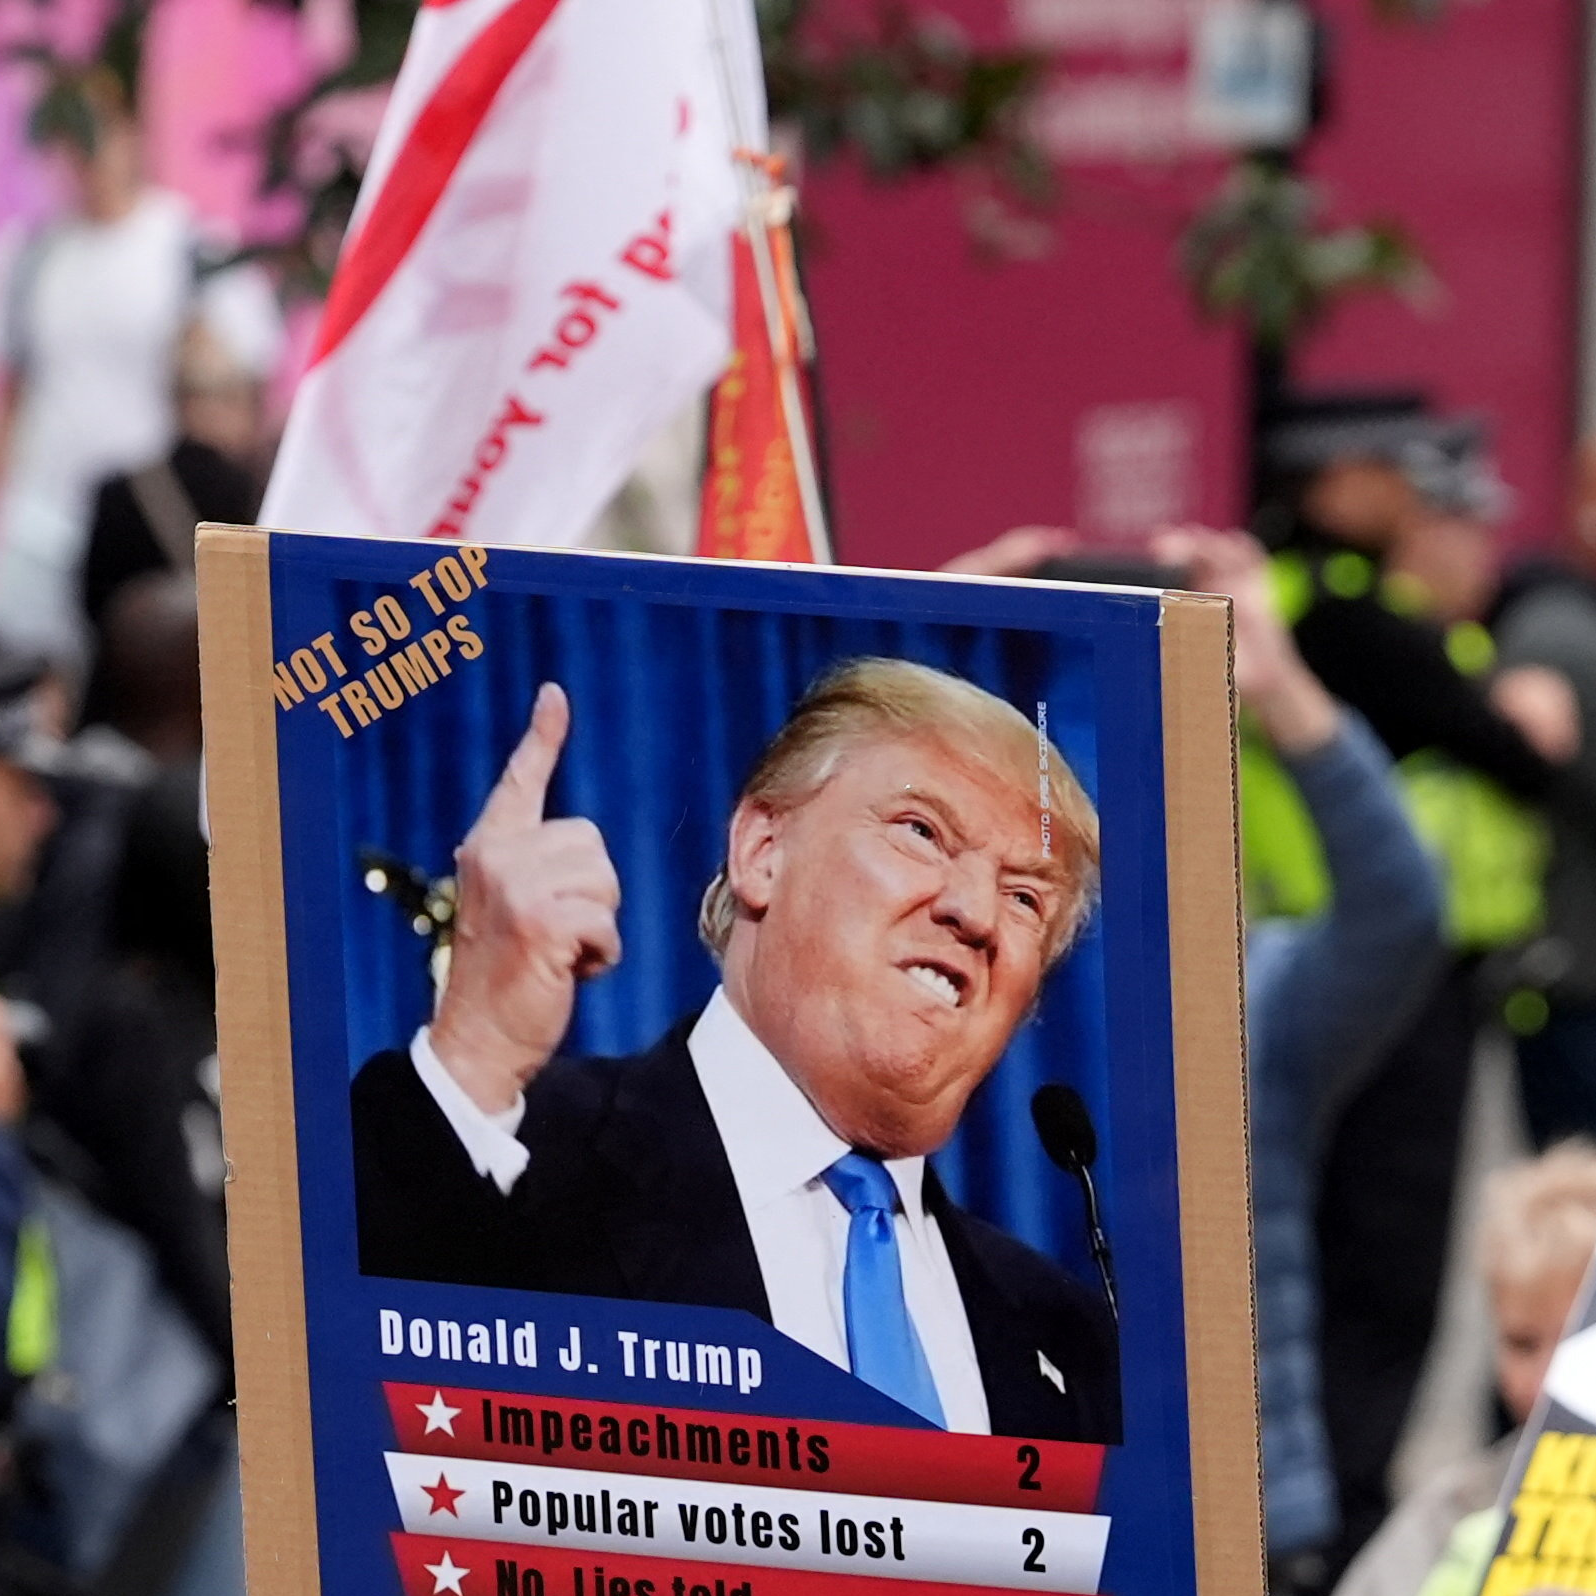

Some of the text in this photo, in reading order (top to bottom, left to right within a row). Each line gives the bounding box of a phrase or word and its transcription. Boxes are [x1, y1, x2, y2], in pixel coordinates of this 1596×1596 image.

[273, 546, 488, 712] NOT SO TOP
[318, 614, 484, 739] TRUMPS
[379, 1309, 763, 1394] Donald J. Trump
[482, 1398, 1042, 1491] Impeachments 2
[492, 1480, 1047, 1573] Popular votes lost 2
